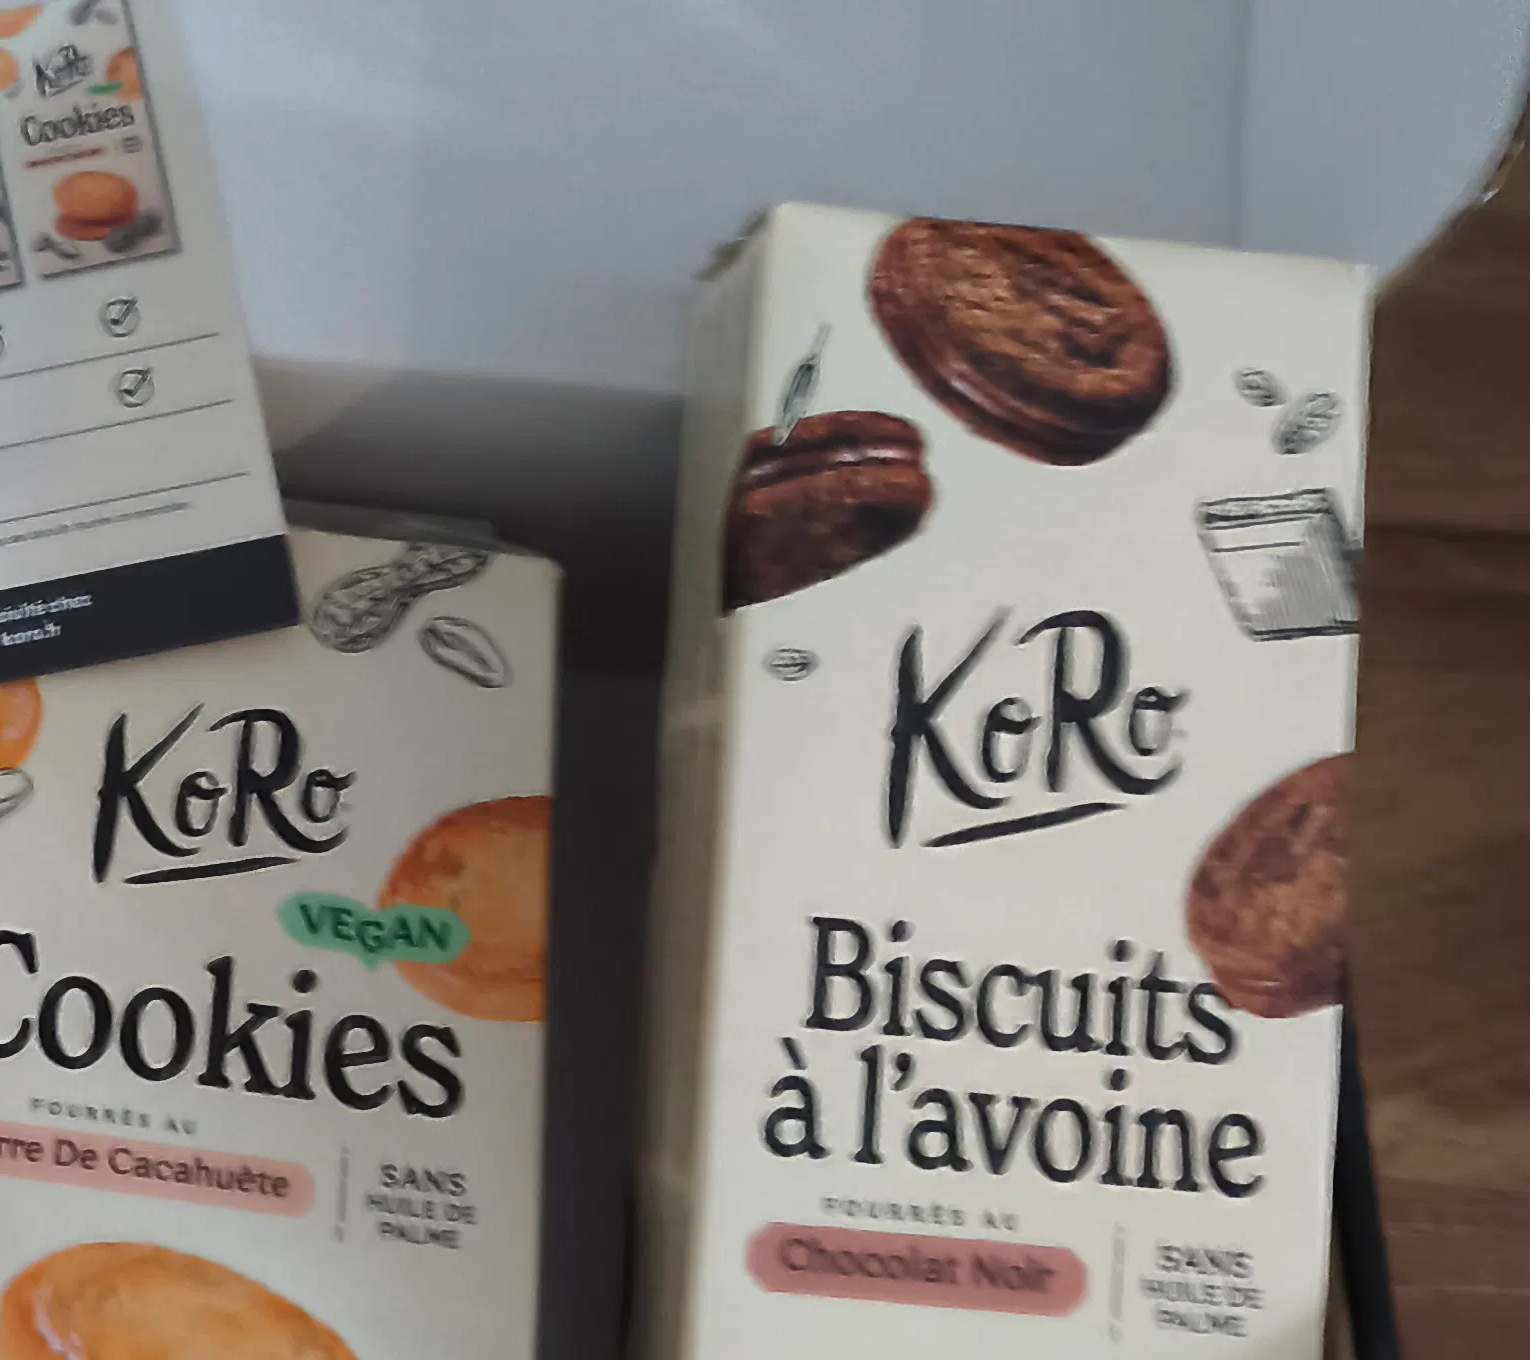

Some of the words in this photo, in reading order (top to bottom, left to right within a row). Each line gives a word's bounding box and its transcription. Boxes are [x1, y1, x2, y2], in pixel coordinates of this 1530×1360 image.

[20, 103, 135, 146] Cookies
[884, 605, 1192, 849] KoRo
[93, 703, 357, 884] KoRo
[299, 904, 452, 954] VEGAN
[805, 915, 1237, 1065] Biscuits
[764, 1037, 829, 1160] à
[854, 1044, 1265, 1199] l'avoine
[55, 1139, 98, 1170] De
[108, 1147, 291, 1198] Cacahuète
[381, 1163, 467, 1197] SANS
[779, 1238, 961, 1285] Chocolat
[972, 1250, 1056, 1293] Noir
[1155, 1245, 1254, 1279] SANS
